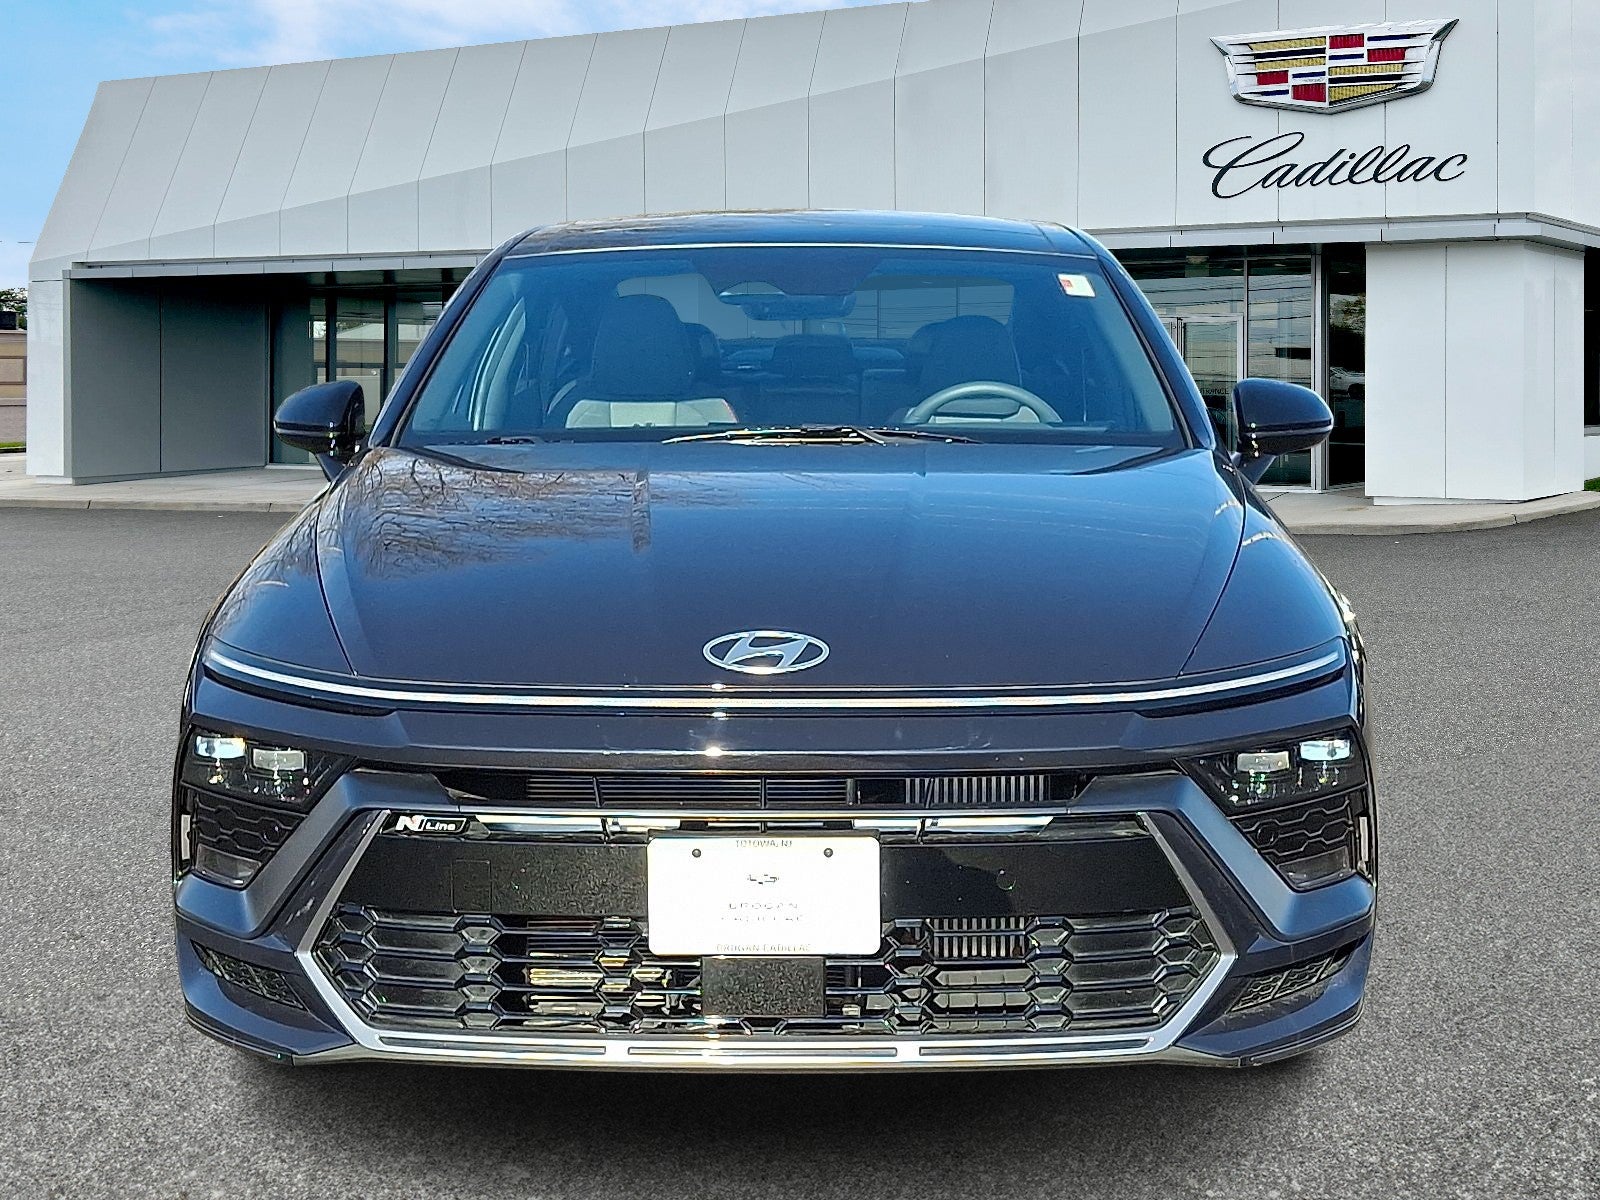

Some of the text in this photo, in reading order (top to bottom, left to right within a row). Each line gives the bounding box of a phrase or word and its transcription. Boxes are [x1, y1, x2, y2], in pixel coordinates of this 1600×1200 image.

[1202, 131, 1468, 199] Cadillac
[395, 815, 456, 832] N Line
